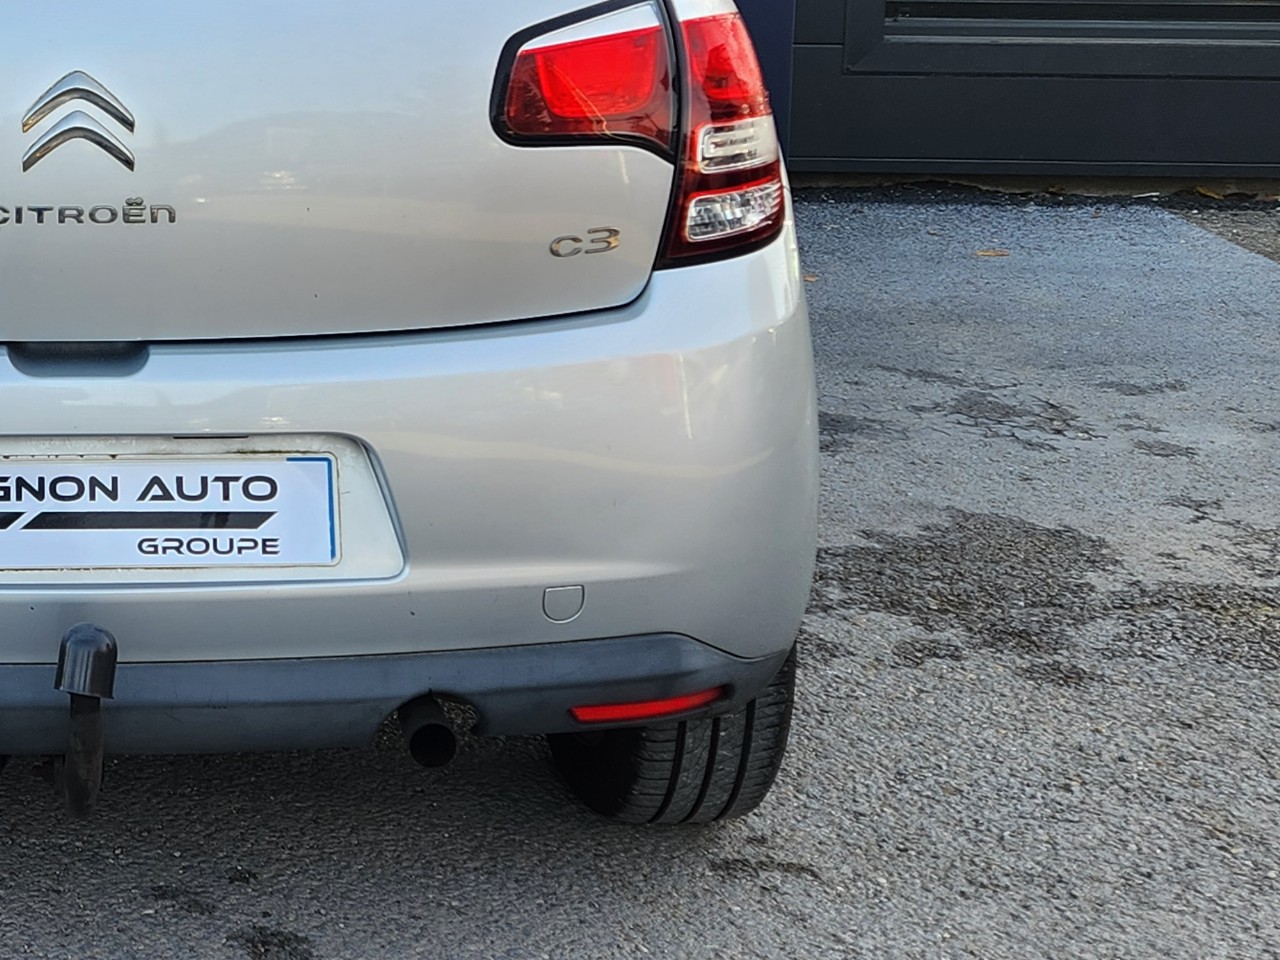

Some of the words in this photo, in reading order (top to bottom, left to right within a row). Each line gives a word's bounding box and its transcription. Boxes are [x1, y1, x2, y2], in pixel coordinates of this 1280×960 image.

[548, 226, 621, 258] C3
[135, 474, 279, 503] AUTO
[136, 536, 281, 556] GROUPE
